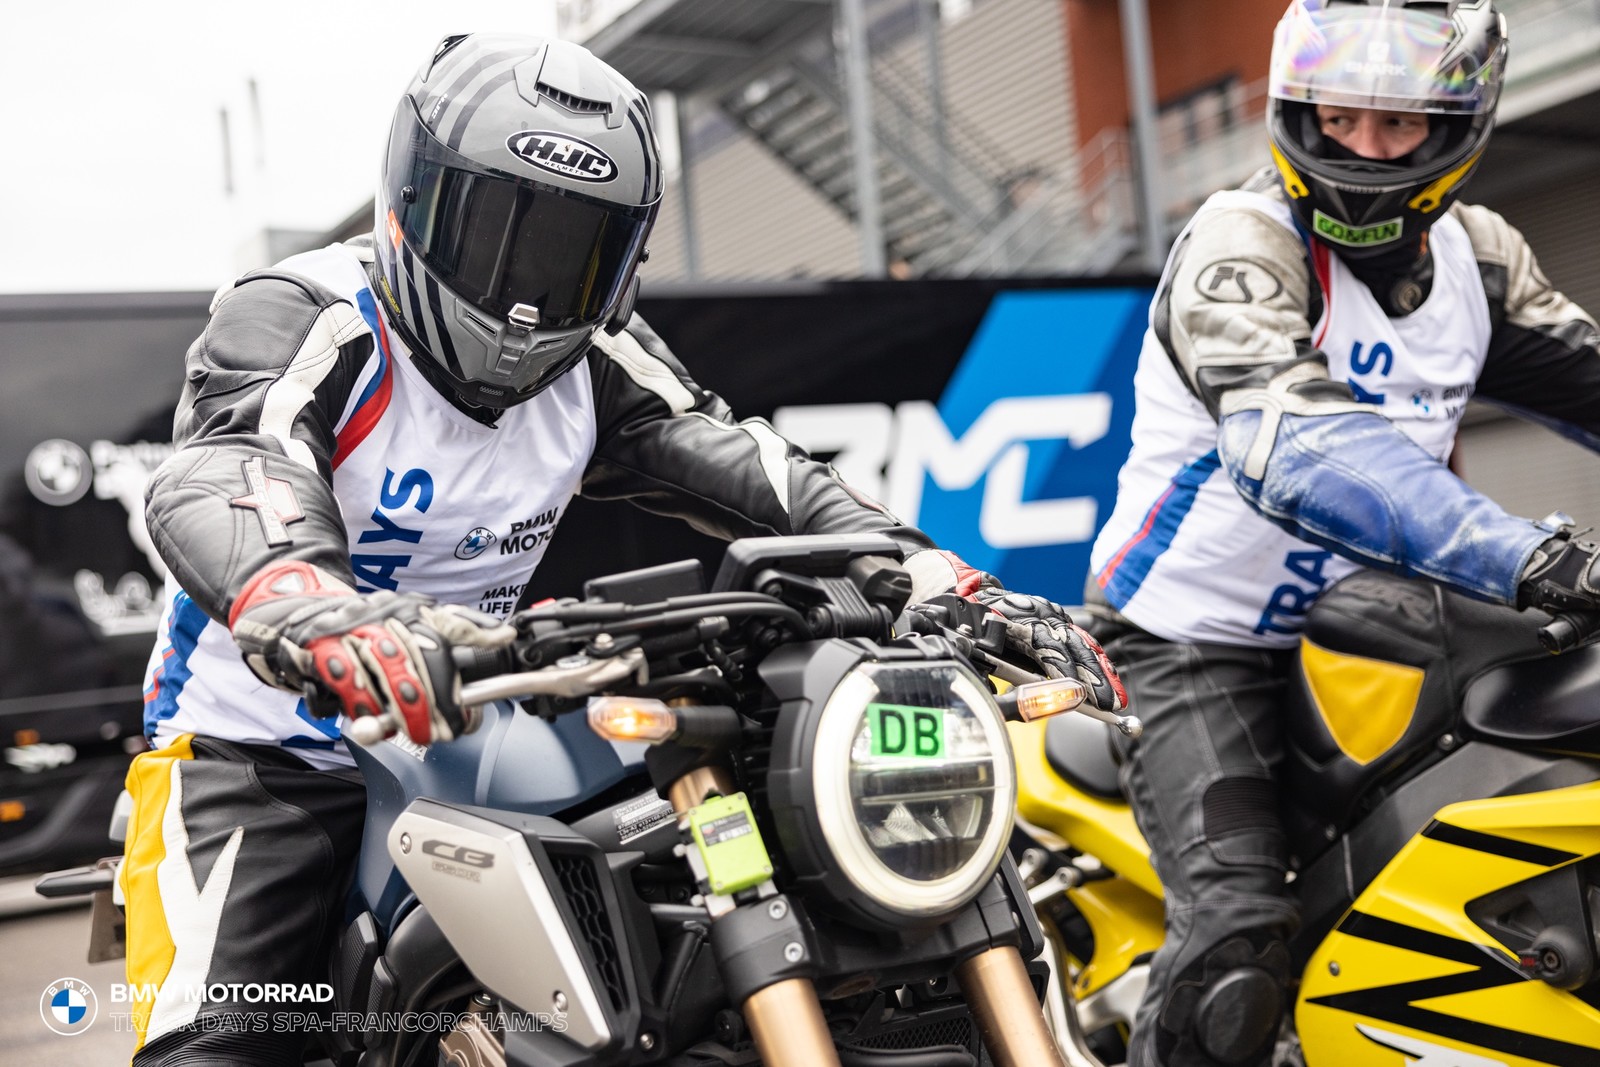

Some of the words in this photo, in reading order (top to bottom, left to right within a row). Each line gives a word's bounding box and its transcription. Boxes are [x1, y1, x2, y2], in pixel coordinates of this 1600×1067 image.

[521, 136, 609, 177] HJC
[544, 160, 585, 176] HELMETS
[350, 466, 434, 593] AYS
[878, 709, 939, 757] DB
[422, 839, 495, 869] CB
